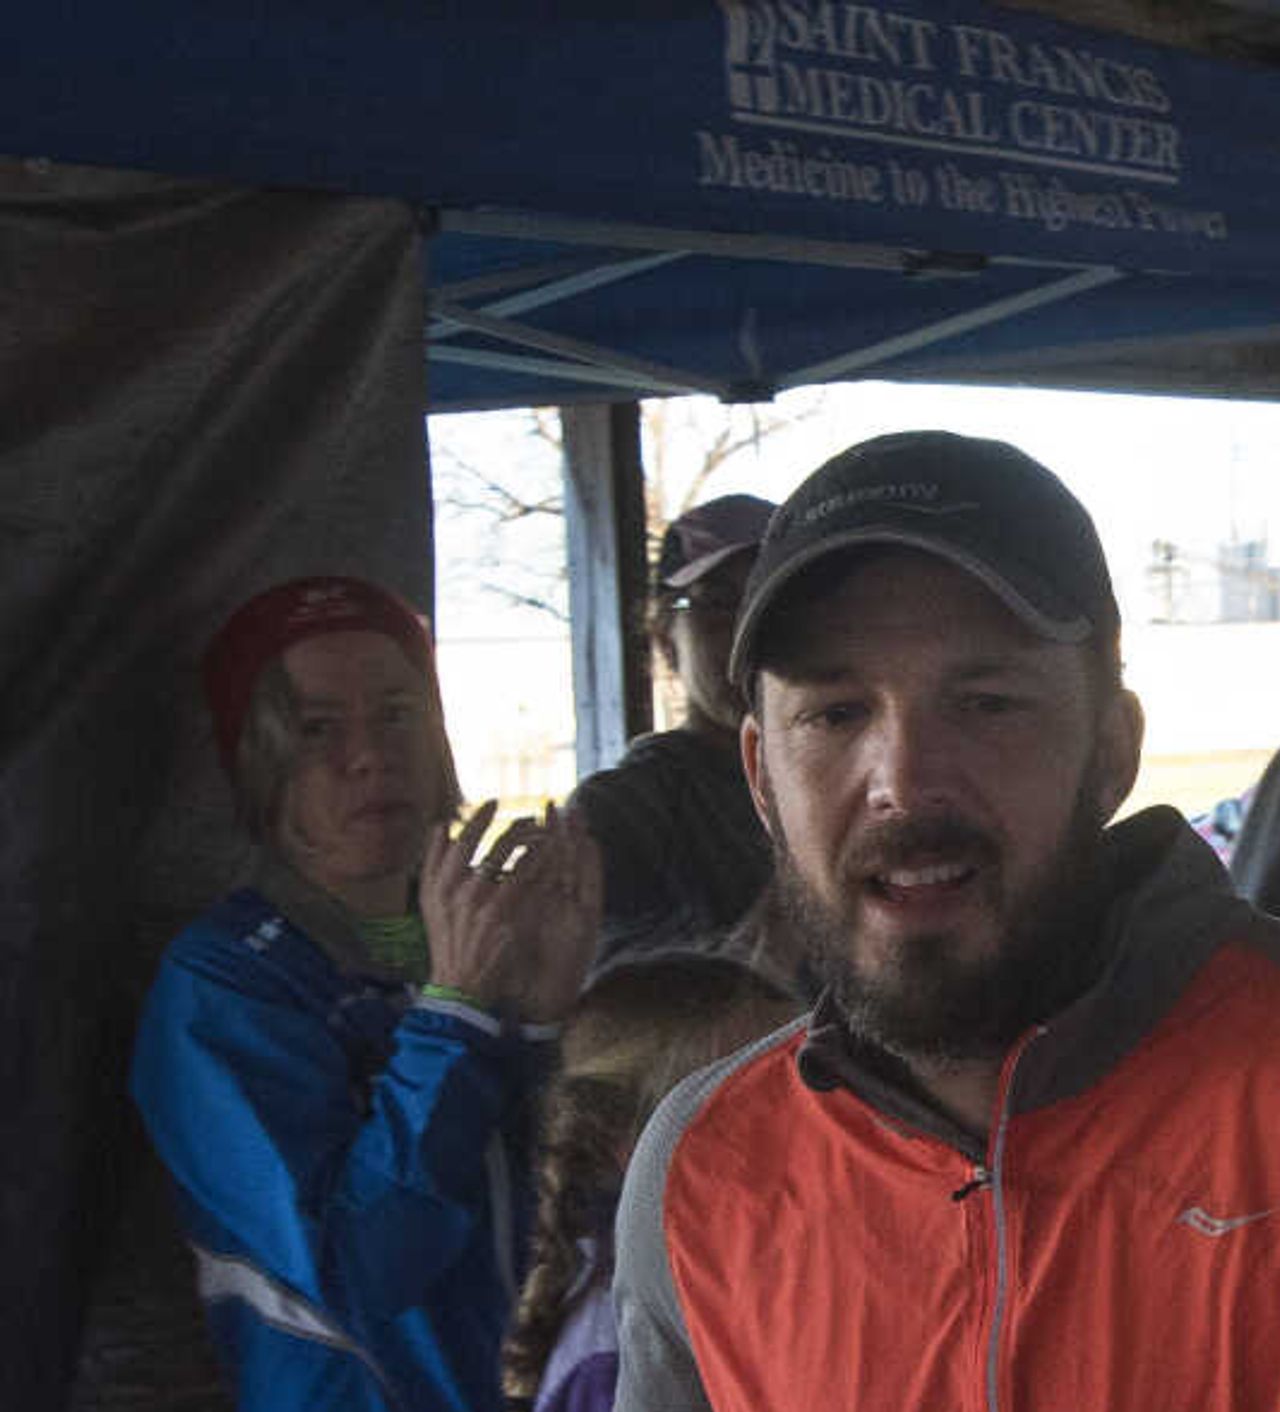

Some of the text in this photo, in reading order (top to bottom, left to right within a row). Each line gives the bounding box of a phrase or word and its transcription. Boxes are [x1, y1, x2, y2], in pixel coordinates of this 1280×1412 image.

[777, 0, 1172, 113] SAINT FRANCIS
[696, 131, 886, 203] Medicine
[888, 160, 928, 205] to
[784, 69, 1182, 168] MEDICAL CENTER
